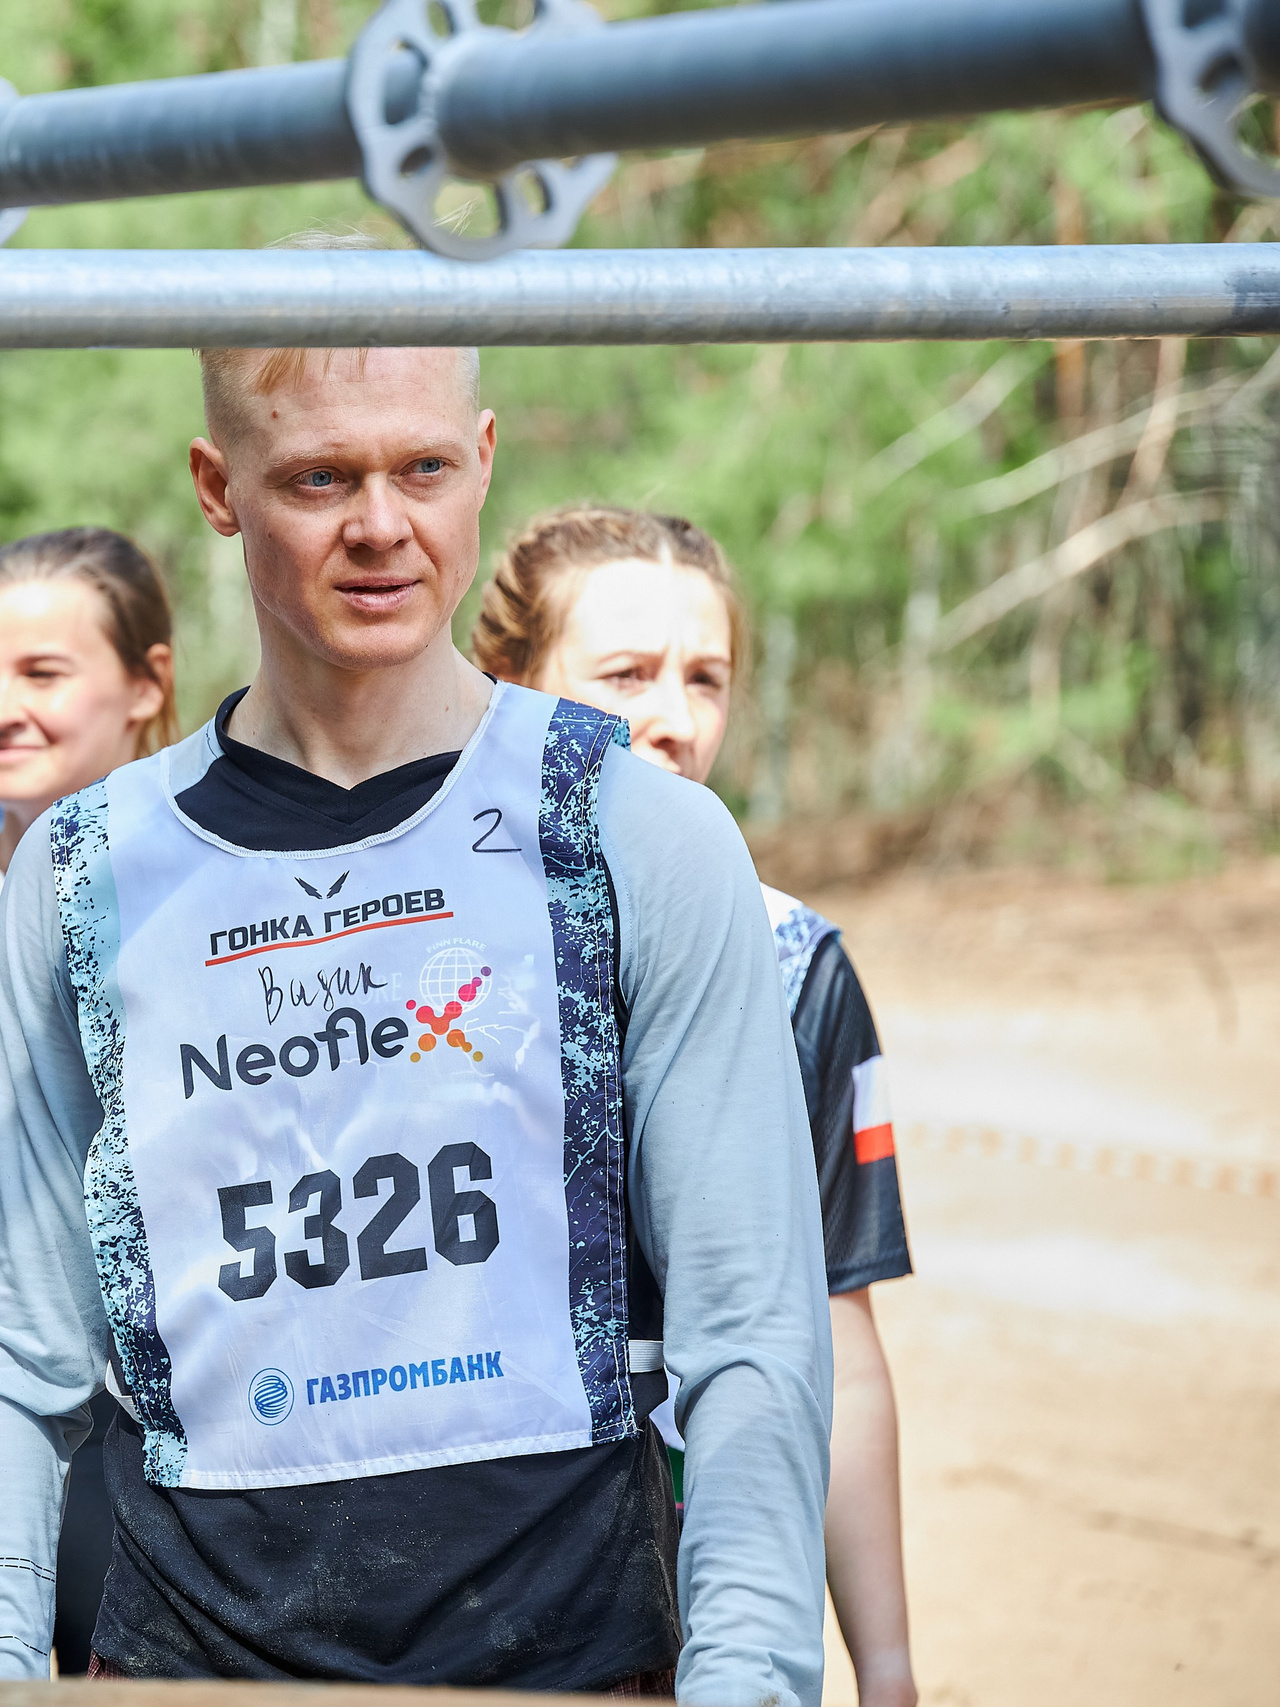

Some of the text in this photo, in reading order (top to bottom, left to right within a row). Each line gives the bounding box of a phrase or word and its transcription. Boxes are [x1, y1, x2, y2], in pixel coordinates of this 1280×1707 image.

[471, 808, 522, 853] 2
[209, 888, 446, 956] ГОНКА ГЕРОЕВ
[452, 937, 487, 951] FLARE
[217, 1141, 500, 1302] 5326
[306, 1350, 504, 1406] ГАЗПРОМБАНК
